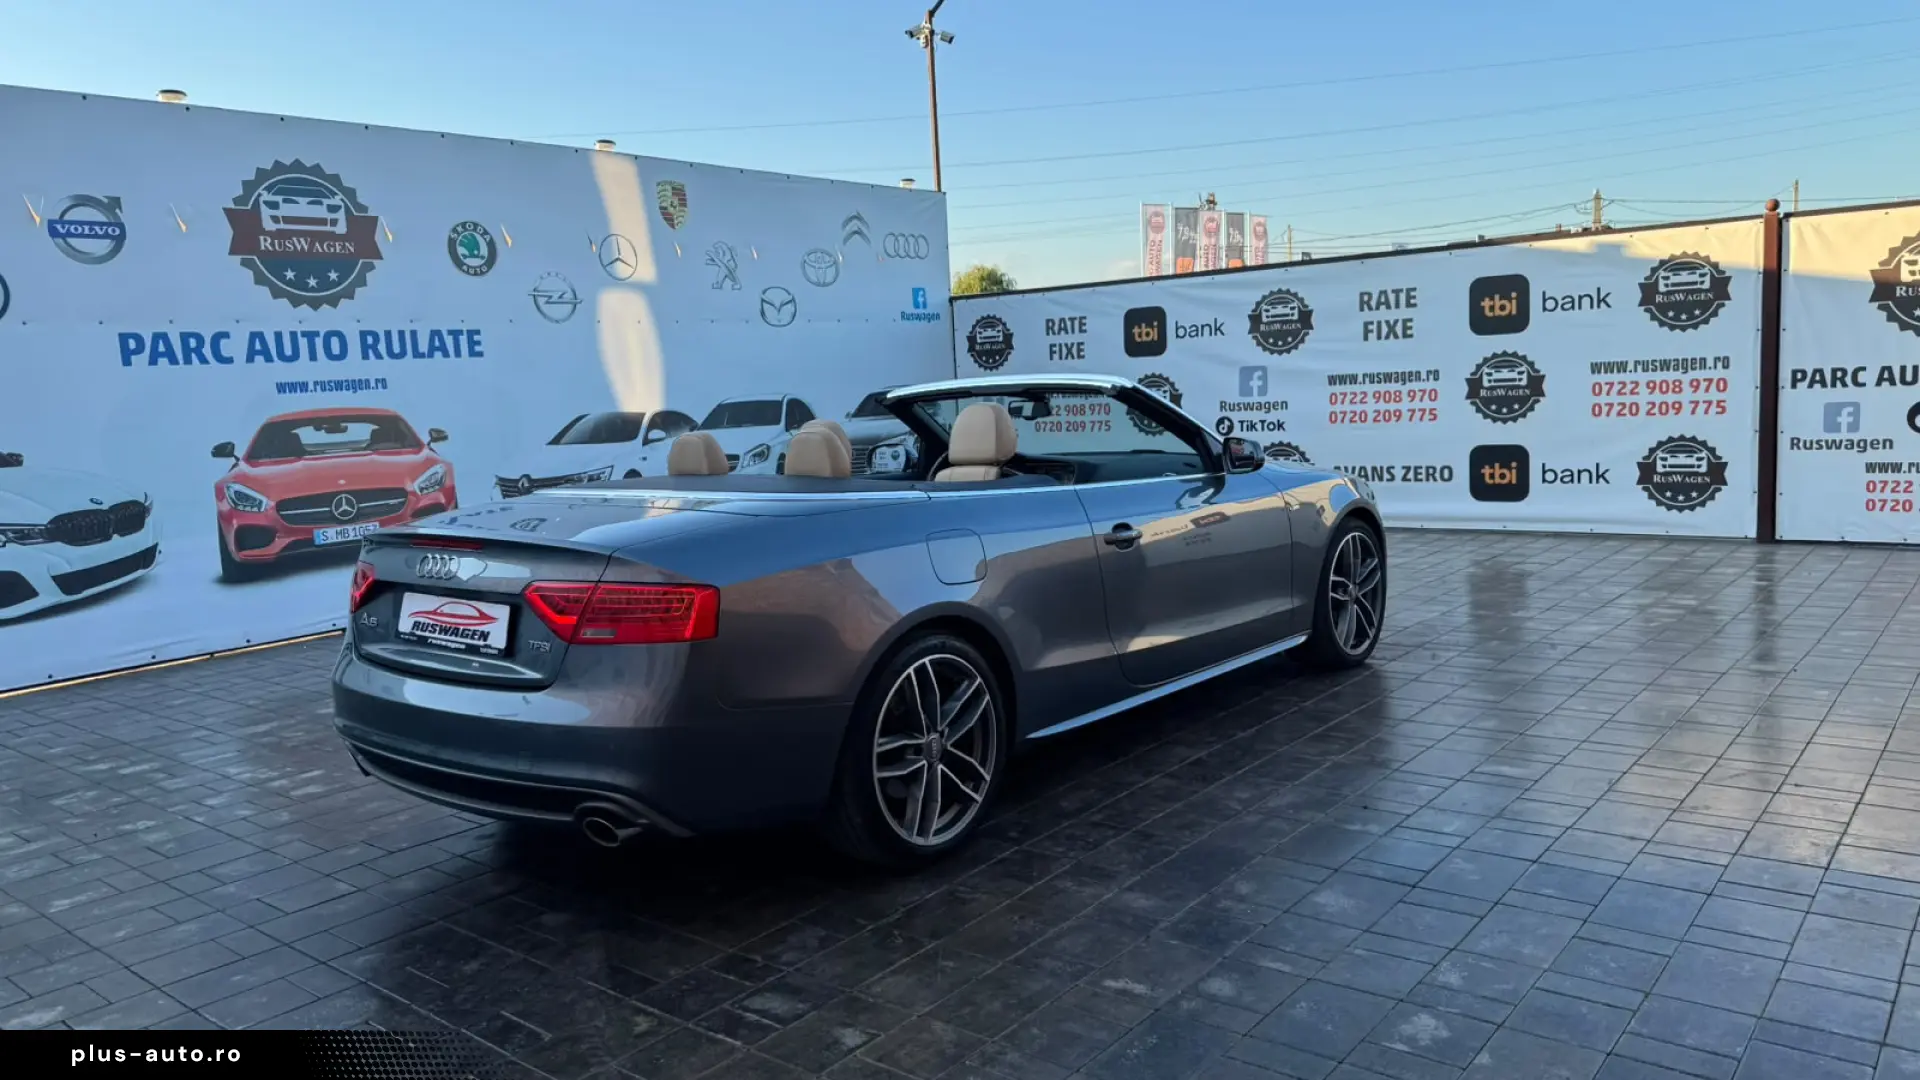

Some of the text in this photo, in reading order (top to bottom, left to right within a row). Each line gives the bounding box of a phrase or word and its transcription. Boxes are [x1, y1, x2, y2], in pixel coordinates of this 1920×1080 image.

[52, 224, 121, 237] VOLVO
[1358, 286, 1418, 312] RATE
[1480, 287, 1612, 318] tbi bank
[1045, 316, 1087, 336] RATE
[1132, 318, 1225, 342] tbi bank
[1362, 318, 1414, 341] FIXE
[118, 328, 485, 367] PARC AUTO RULATE
[1049, 342, 1086, 361] FIXE
[1590, 355, 1730, 375] www.ruswagen.ro
[275, 376, 388, 395] www.ruswagen.ro
[1327, 369, 1440, 387] www.ruswagen.ro
[1591, 377, 1728, 397] 0722 908 970
[1790, 366, 1867, 389] PARC
[1328, 388, 1438, 406] 0722 908 970
[1064, 404, 1086, 416] 908
[1088, 403, 1111, 416] 970
[1219, 400, 1289, 414] Ruswagen
[1328, 408, 1438, 425] 0720 209 775
[1591, 399, 1728, 418] 0720 209 775
[1034, 421, 1111, 432] 0720 209 775
[1238, 419, 1286, 433] TikTok
[1789, 436, 1894, 453] Ruswagen
[1401, 465, 1453, 482] ZERO
[1480, 463, 1611, 486] tbi bank
[1865, 480, 1914, 493] 0722
[1865, 499, 1914, 512] 0720
[411, 620, 491, 643] RUSWAGEN
